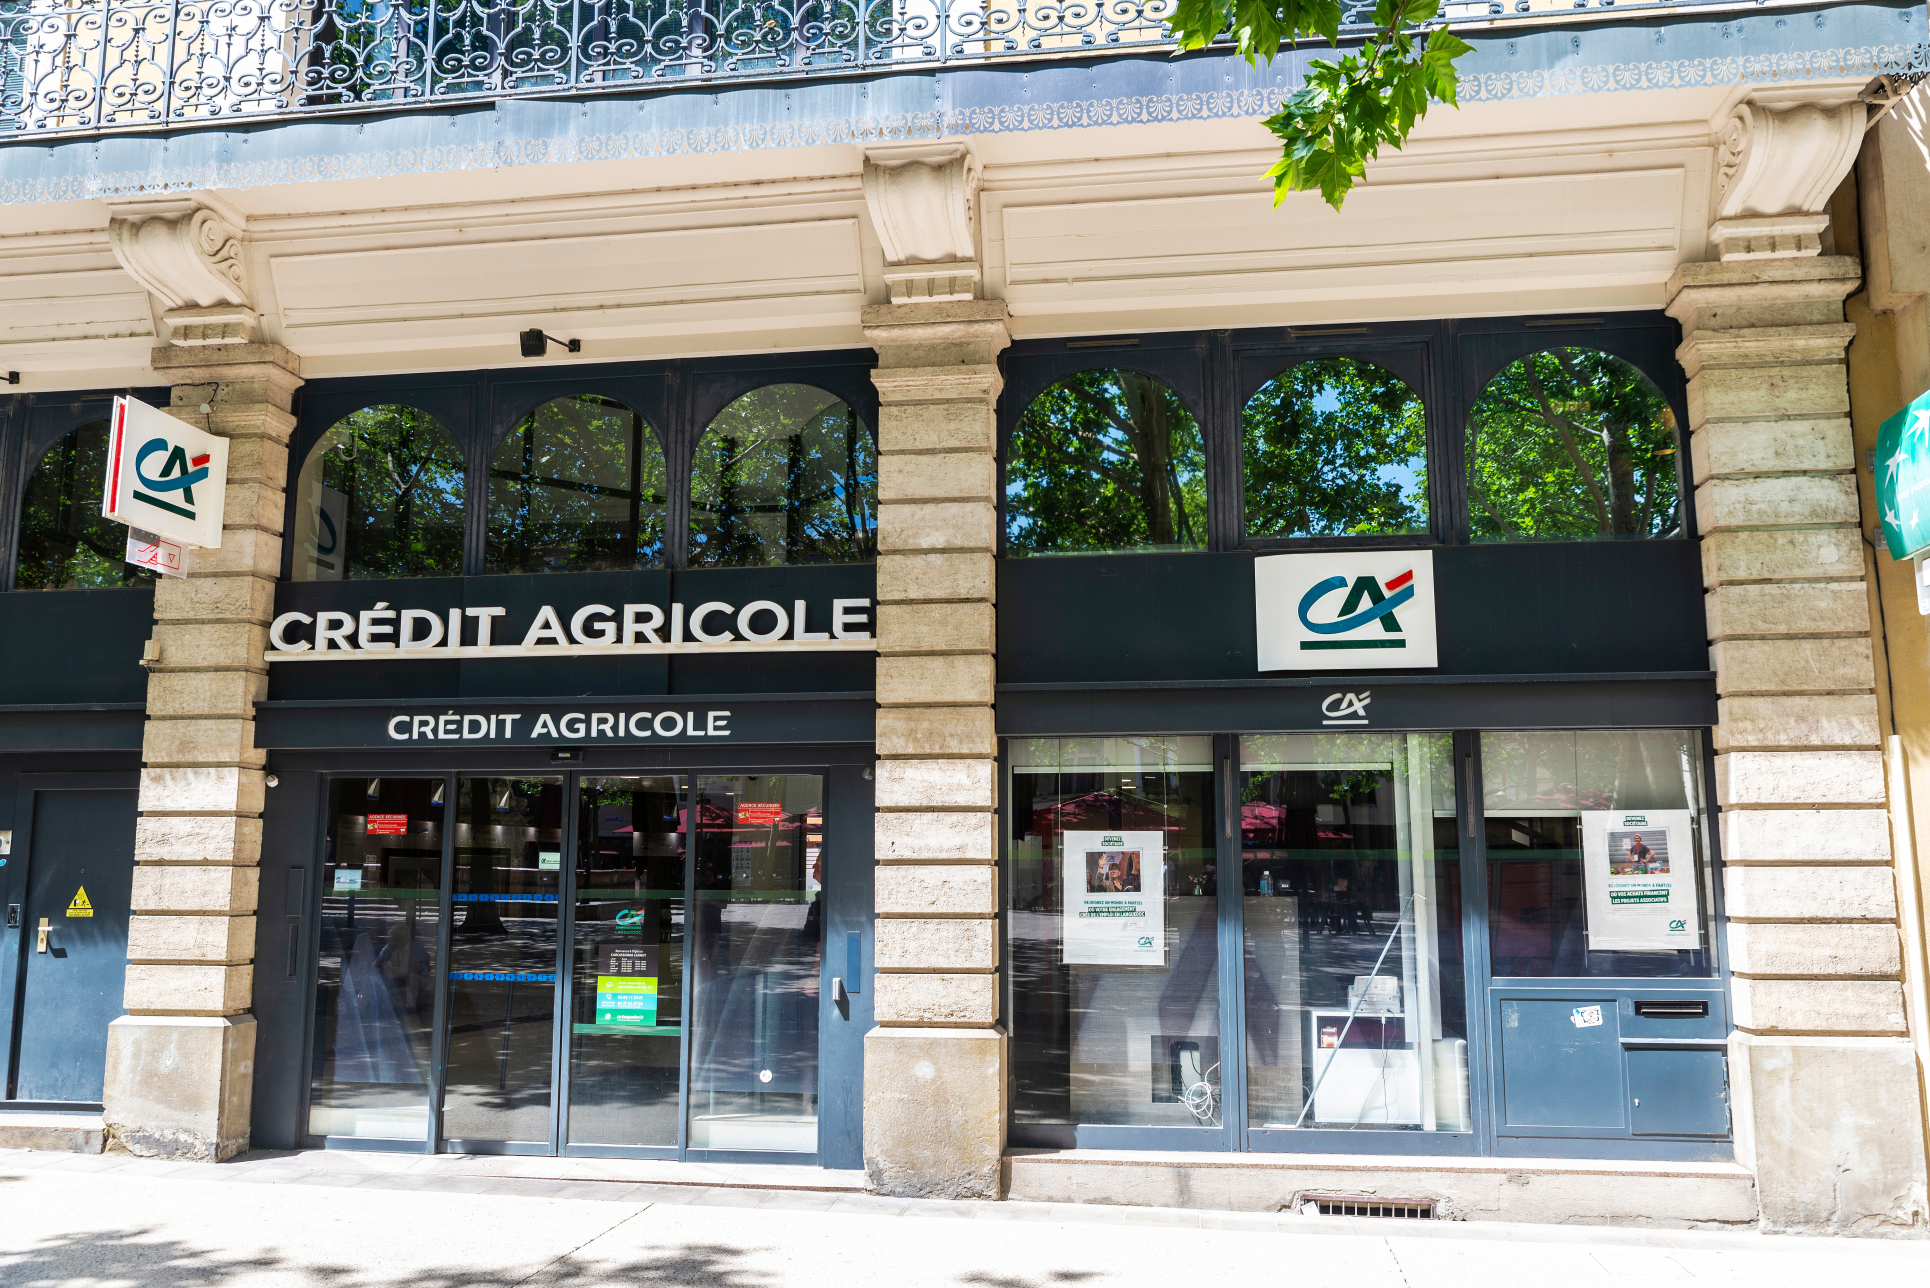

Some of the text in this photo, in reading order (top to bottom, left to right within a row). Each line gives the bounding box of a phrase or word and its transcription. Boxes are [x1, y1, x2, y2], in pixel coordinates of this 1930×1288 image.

[135, 438, 210, 506] CA
[1897, 488, 1910, 501] BNP
[1298, 569, 1415, 634] CA
[269, 598, 871, 652] CRÉDIT AGRICOLE
[1321, 690, 1371, 717] CA
[388, 710, 731, 740] CRÉDIT AGRICOLE
[616, 908, 644, 925] CA
[1668, 919, 1686, 929] CA
[1138, 936, 1154, 945] CA
